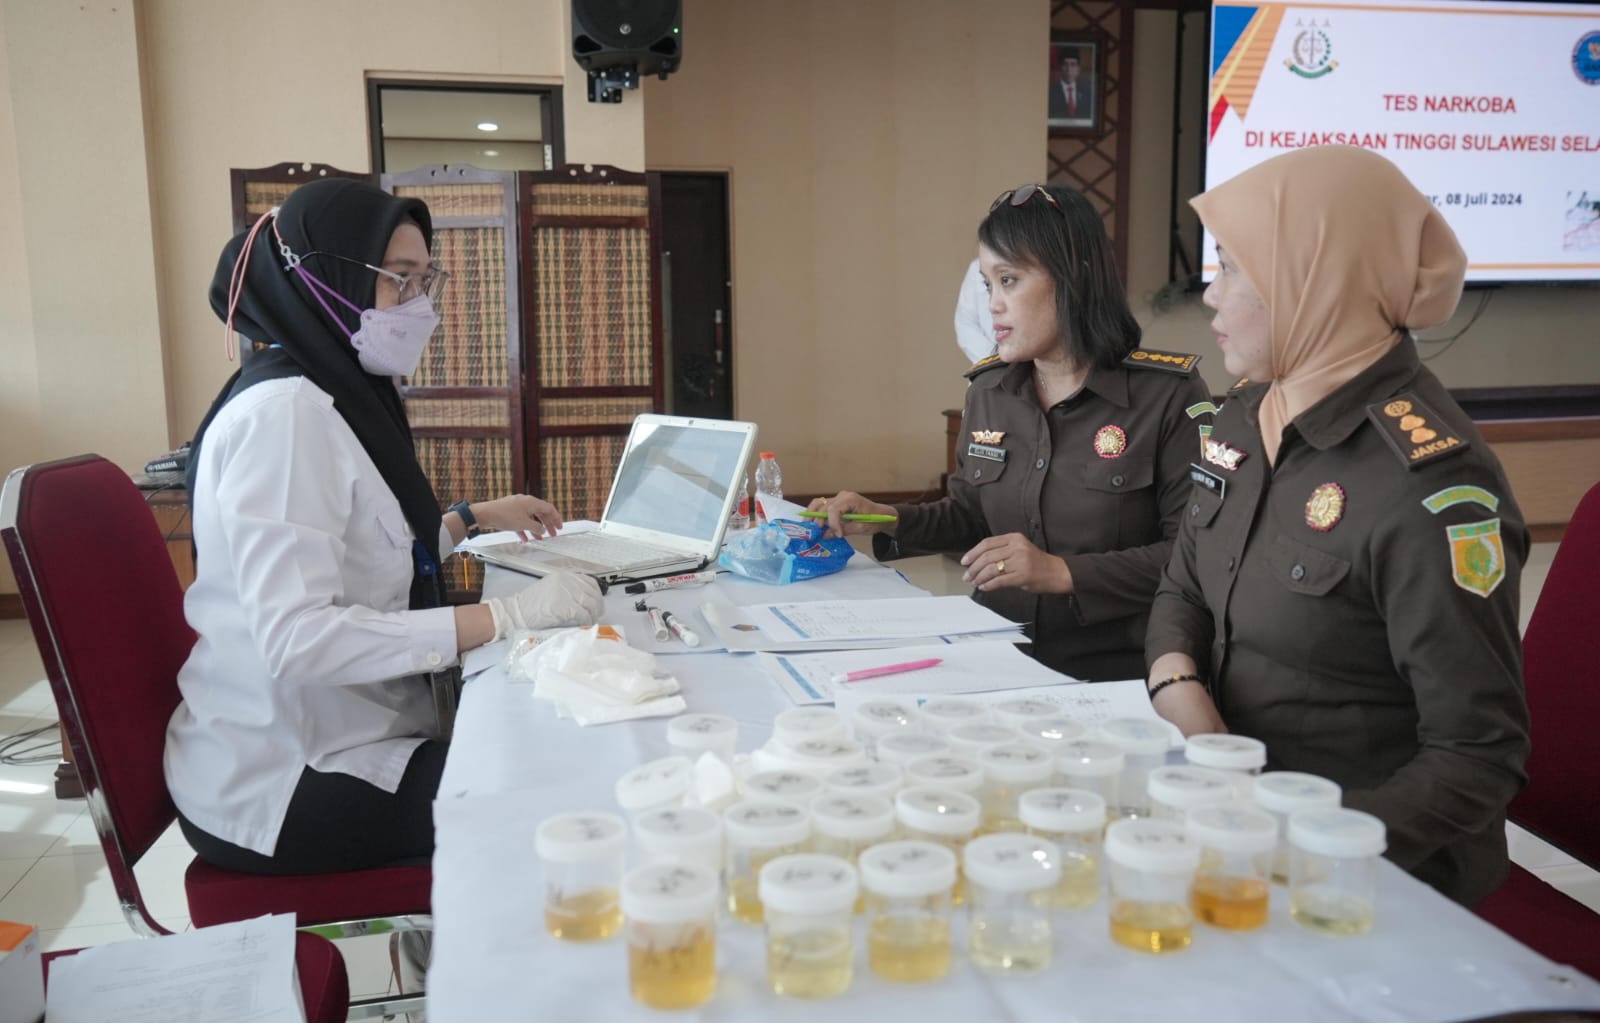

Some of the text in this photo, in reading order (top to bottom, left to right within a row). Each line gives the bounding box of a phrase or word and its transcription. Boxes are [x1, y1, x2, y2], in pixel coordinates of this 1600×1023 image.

[1383, 95, 1517, 113] TES NARKOBA
[1245, 131, 1264, 148] DI
[1270, 132, 1387, 149] KEJAKSAAN
[1393, 134, 1456, 150] TINGGI
[1461, 135, 1556, 151] SULAWESI
[1446, 193, 1461, 204] 08
[1464, 193, 1488, 208] Juli
[1491, 193, 1522, 205] 2024
[1410, 436, 1459, 459] JAKSA
